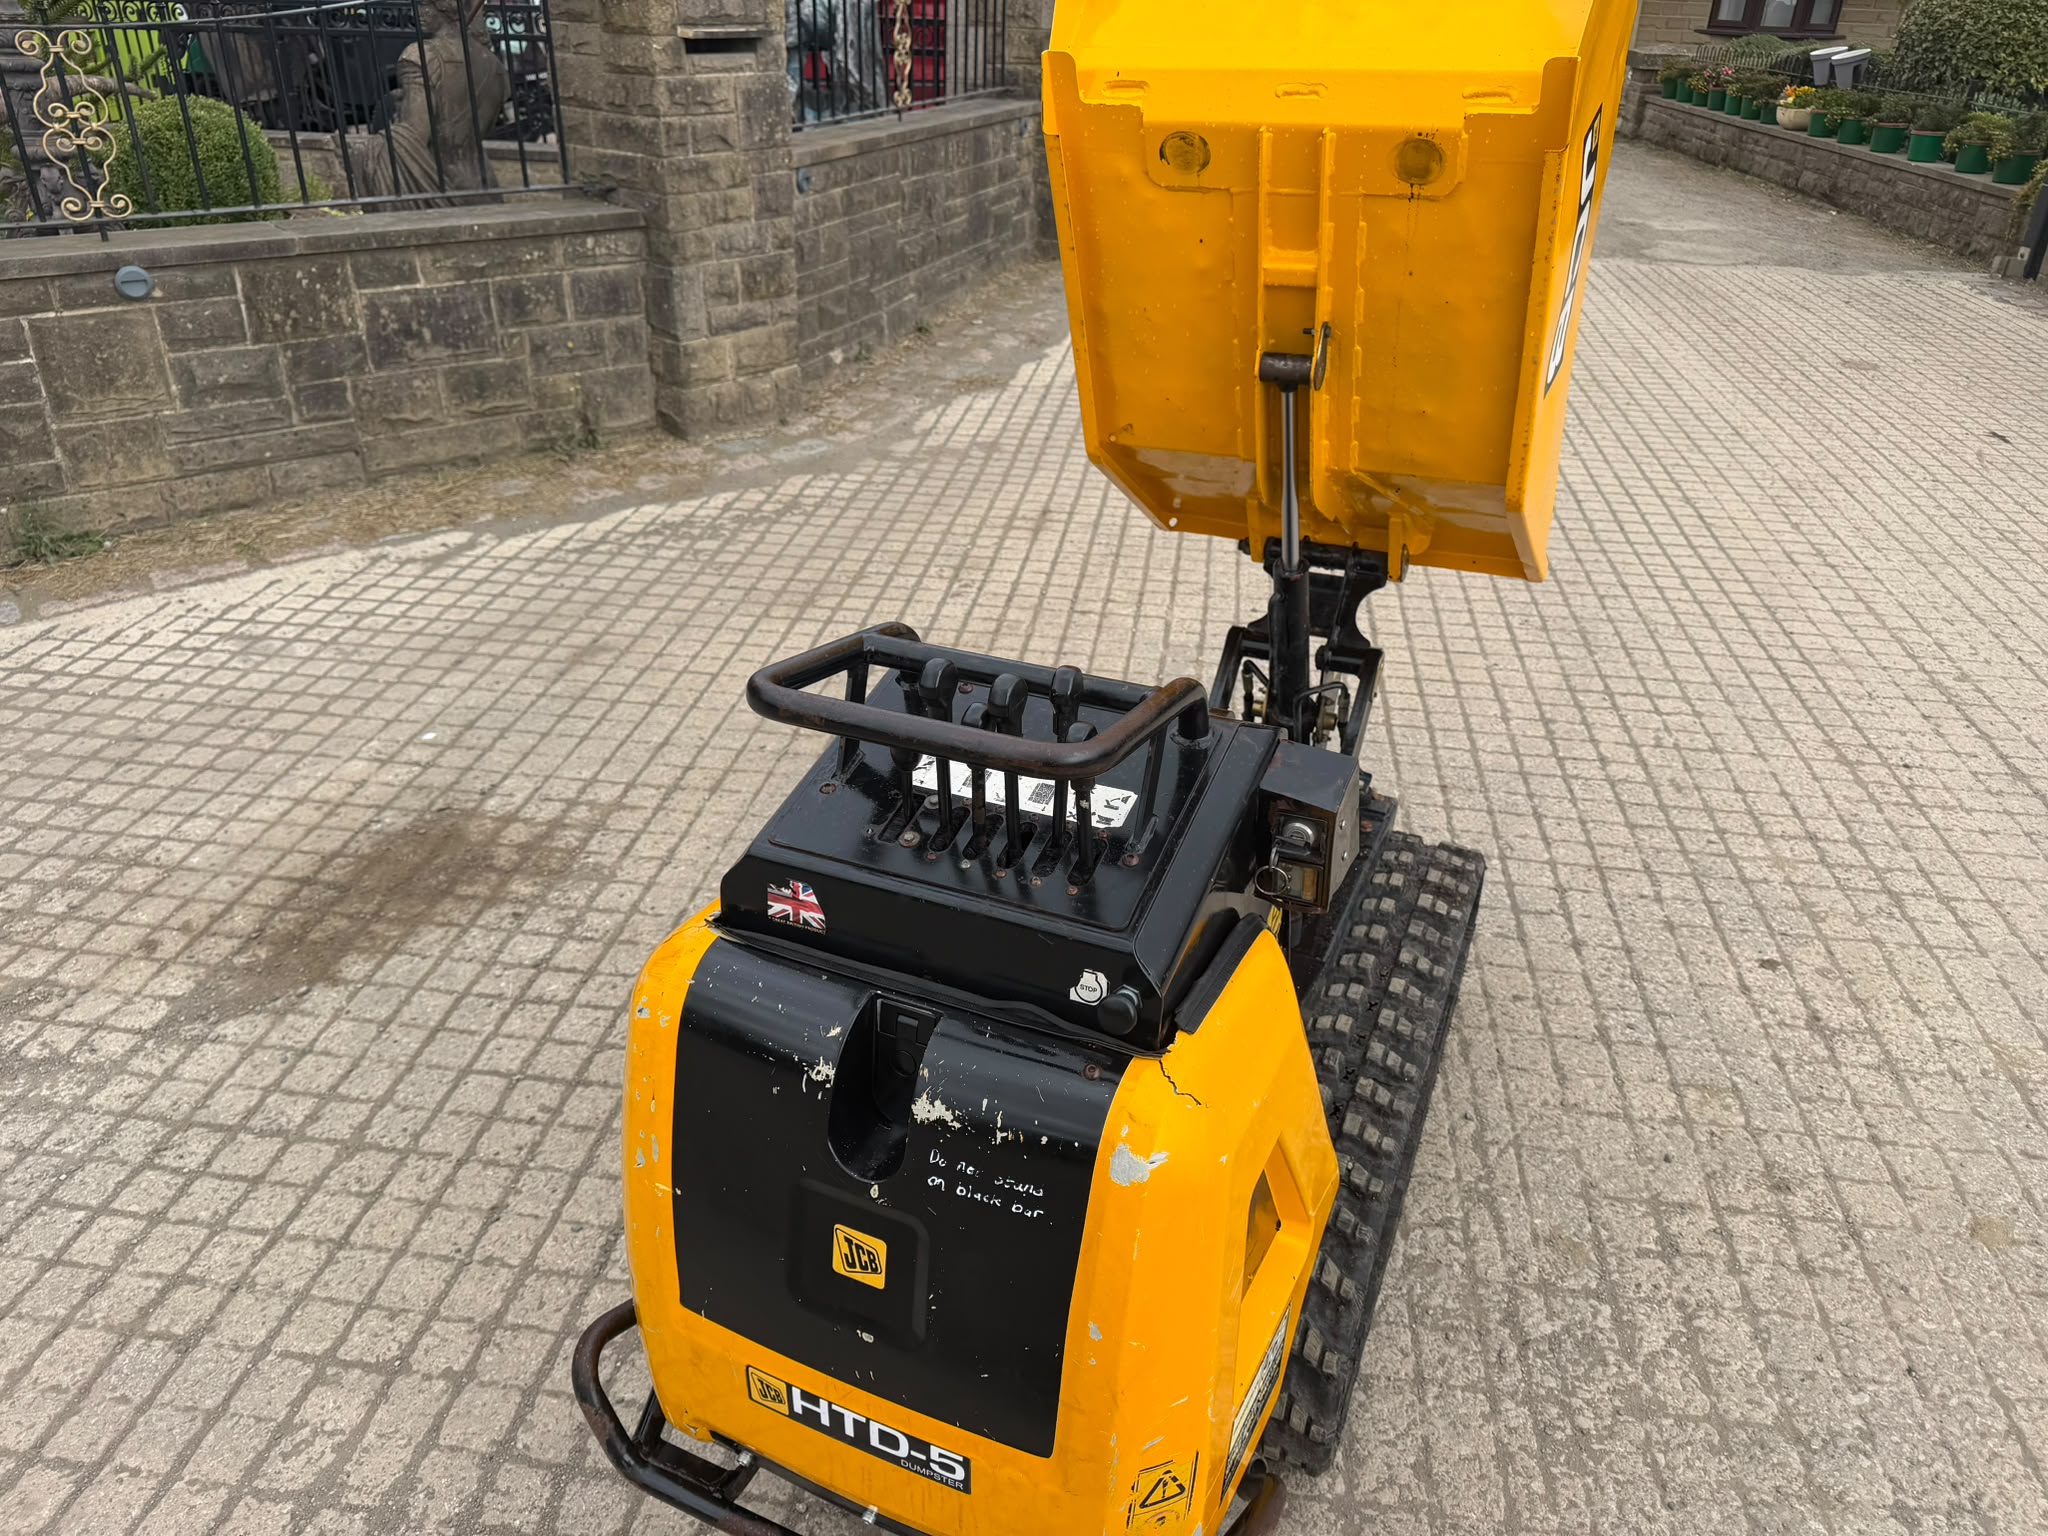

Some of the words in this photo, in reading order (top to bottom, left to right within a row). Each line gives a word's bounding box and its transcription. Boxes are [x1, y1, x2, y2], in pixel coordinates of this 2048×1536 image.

[1080, 983, 1098, 992] STOP
[930, 1148, 947, 1167] Do
[927, 1176, 945, 1192] on
[956, 1181, 1002, 1207] black
[1011, 1200, 1044, 1218] bar
[843, 1234, 880, 1273] JCB
[757, 1378, 784, 1403] JCB
[791, 1385, 966, 1482] HTD-5
[900, 1458, 965, 1490] DUMPSTER
